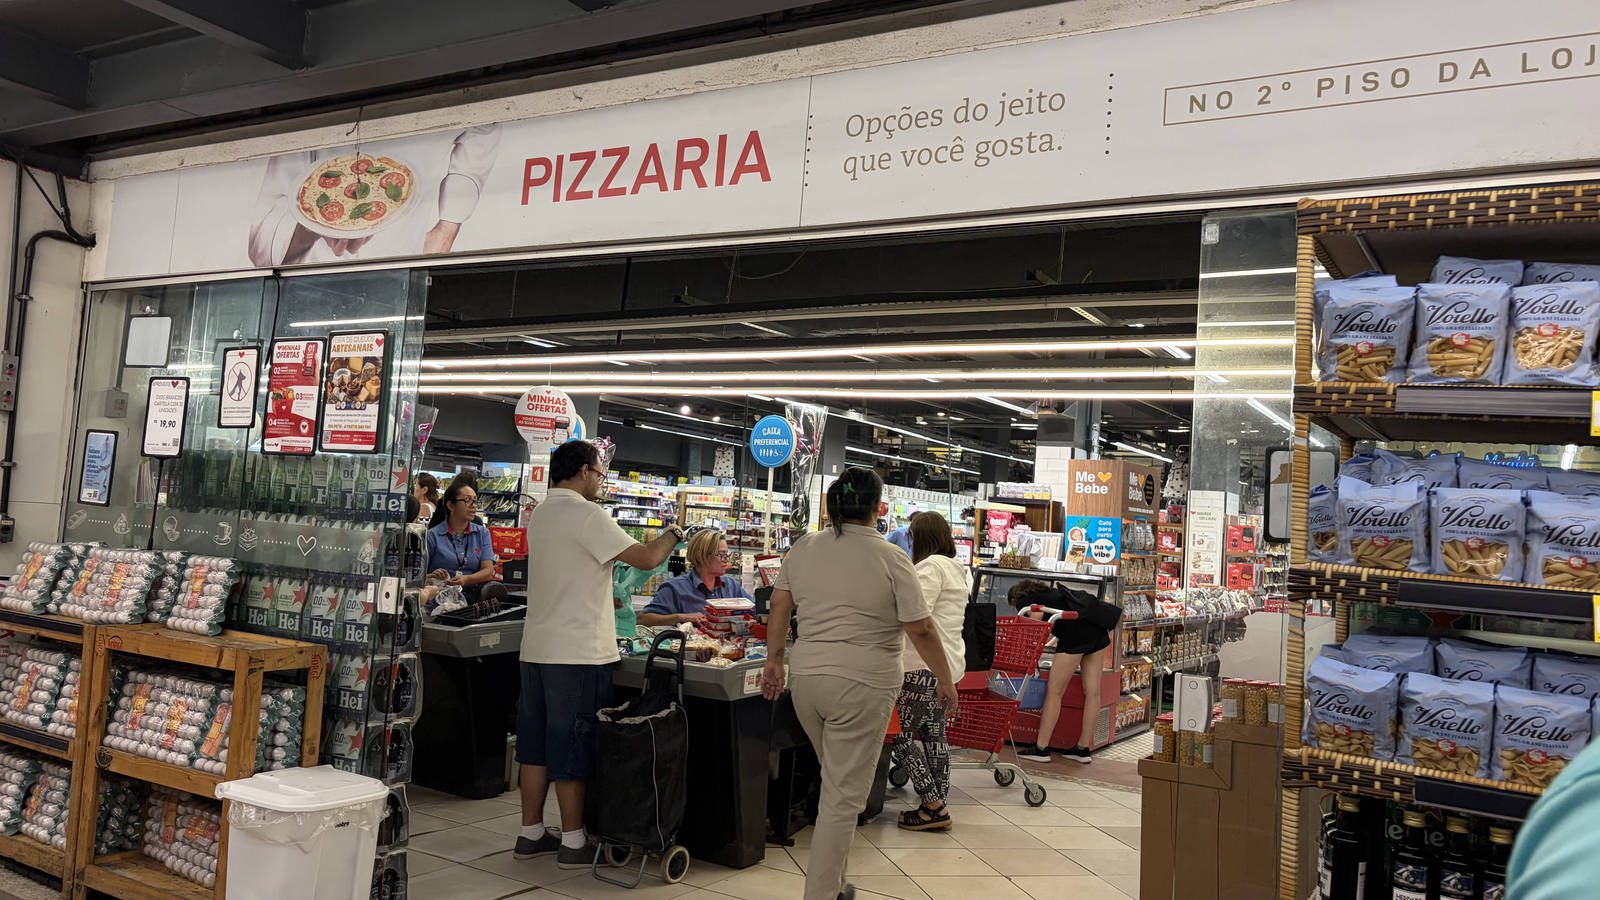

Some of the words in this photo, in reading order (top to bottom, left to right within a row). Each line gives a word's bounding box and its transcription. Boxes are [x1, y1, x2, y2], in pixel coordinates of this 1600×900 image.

[1188, 89, 1234, 114] NO
[1316, 67, 1410, 98] PISO
[1439, 58, 1492, 83] DA
[1521, 44, 1597, 73] LOJ
[845, 106, 943, 142] Opções
[953, 97, 989, 124] do
[995, 89, 1066, 127] jeito
[843, 152, 892, 181] que
[901, 136, 965, 168] você
[974, 131, 1064, 168] gosta.
[521, 130, 772, 206] PIZZARIA
[1426, 301, 1497, 327] Voiello
[1515, 293, 1585, 318] Voiello
[1333, 311, 1398, 334] Voiello
[332, 343, 374, 352] ARTESANAIS
[526, 402, 567, 415] OFERTAS
[527, 394, 567, 407] MINHAS
[159, 420, 177, 428] 19,90
[762, 426, 781, 436] CAIXA
[753, 438, 790, 446] PREFERENCIAL
[1075, 471, 1096, 483] Me
[1075, 482, 1109, 494] Bebe
[1347, 505, 1411, 527] Voiello
[1440, 505, 1513, 530] Voiello
[1094, 549, 1111, 559] vibe
[248, 608, 268, 627] Hei
[278, 612, 300, 632] Hei
[312, 619, 334, 639] Hei
[345, 624, 369, 643] Hei
[339, 691, 363, 711] Hei
[1313, 690, 1374, 720] Voiello
[1413, 706, 1483, 735] Voiello
[1502, 714, 1573, 742] Voiello
